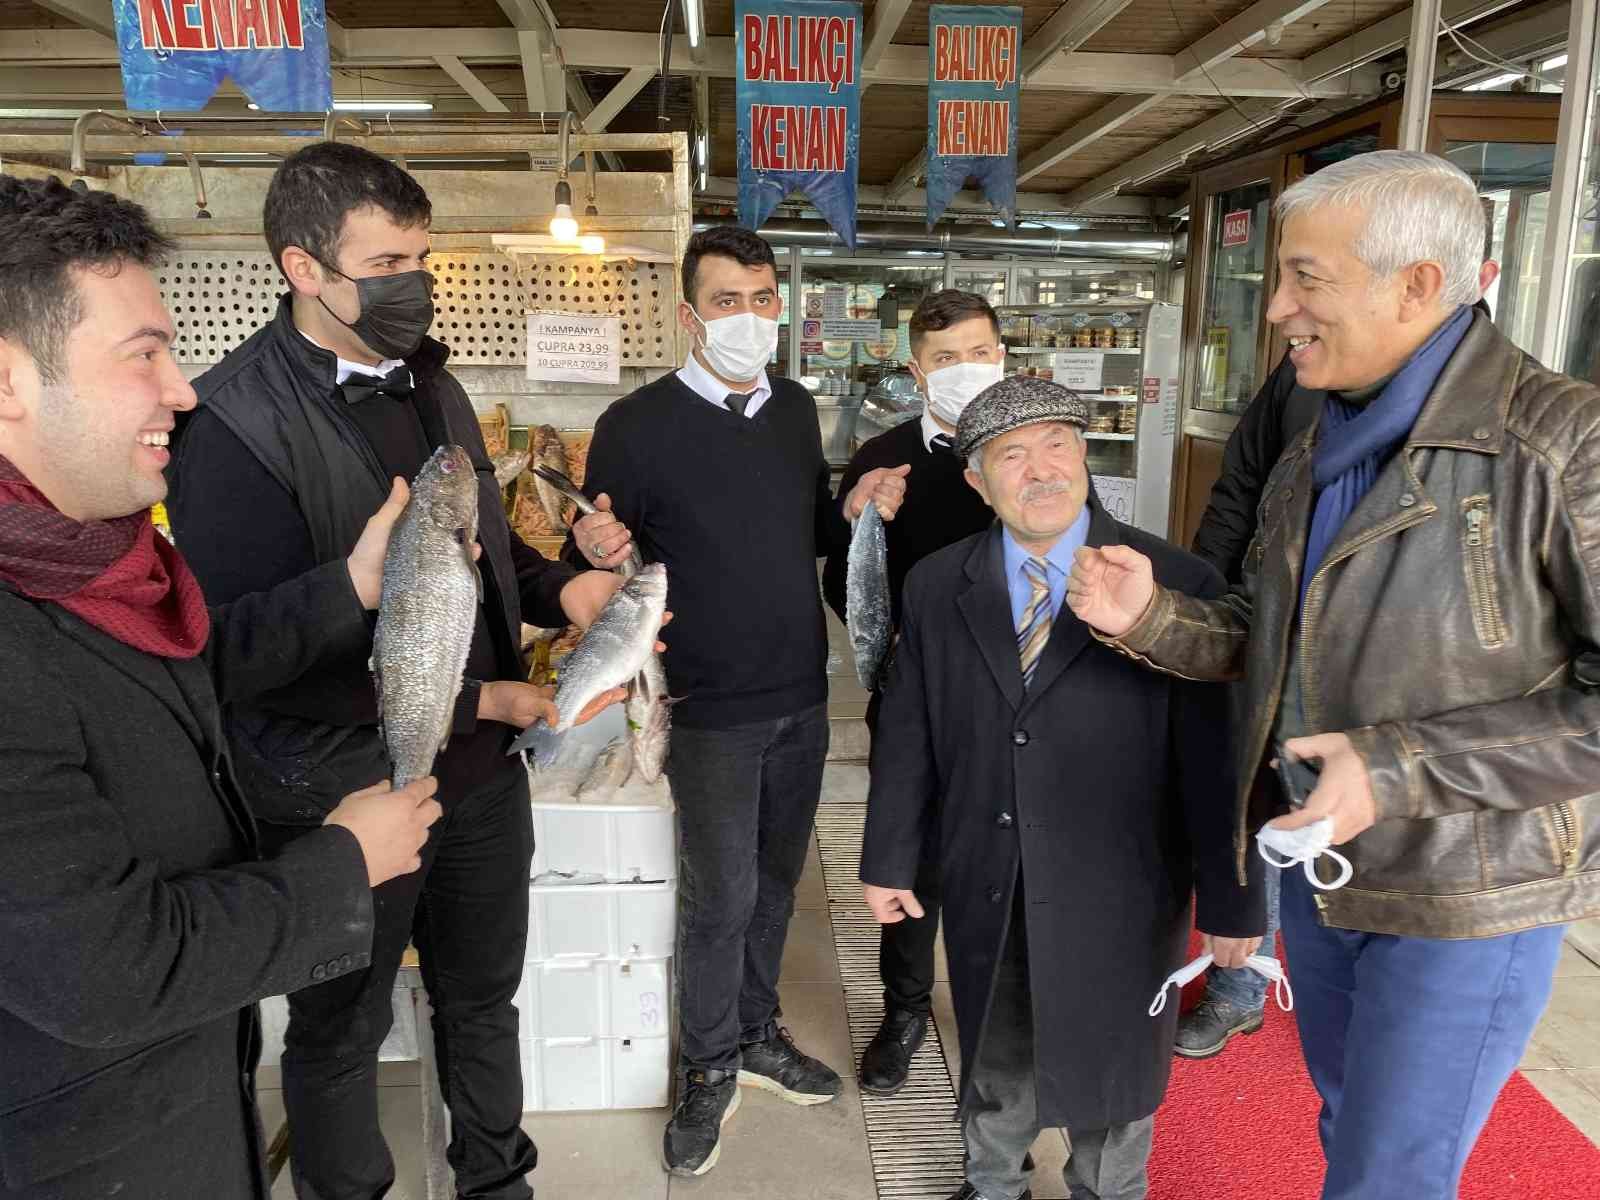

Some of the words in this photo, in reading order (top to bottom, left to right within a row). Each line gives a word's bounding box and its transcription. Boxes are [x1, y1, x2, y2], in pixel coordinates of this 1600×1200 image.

[744, 14, 856, 93] BALIKÇI
[935, 25, 1017, 90] BALIKÇI
[751, 104, 847, 172] KENAN
[937, 100, 1010, 156] KENAN
[1225, 218, 1248, 242] KASA
[537, 341, 576, 352] CUPRA
[545, 325, 600, 336] KAMPANYA
